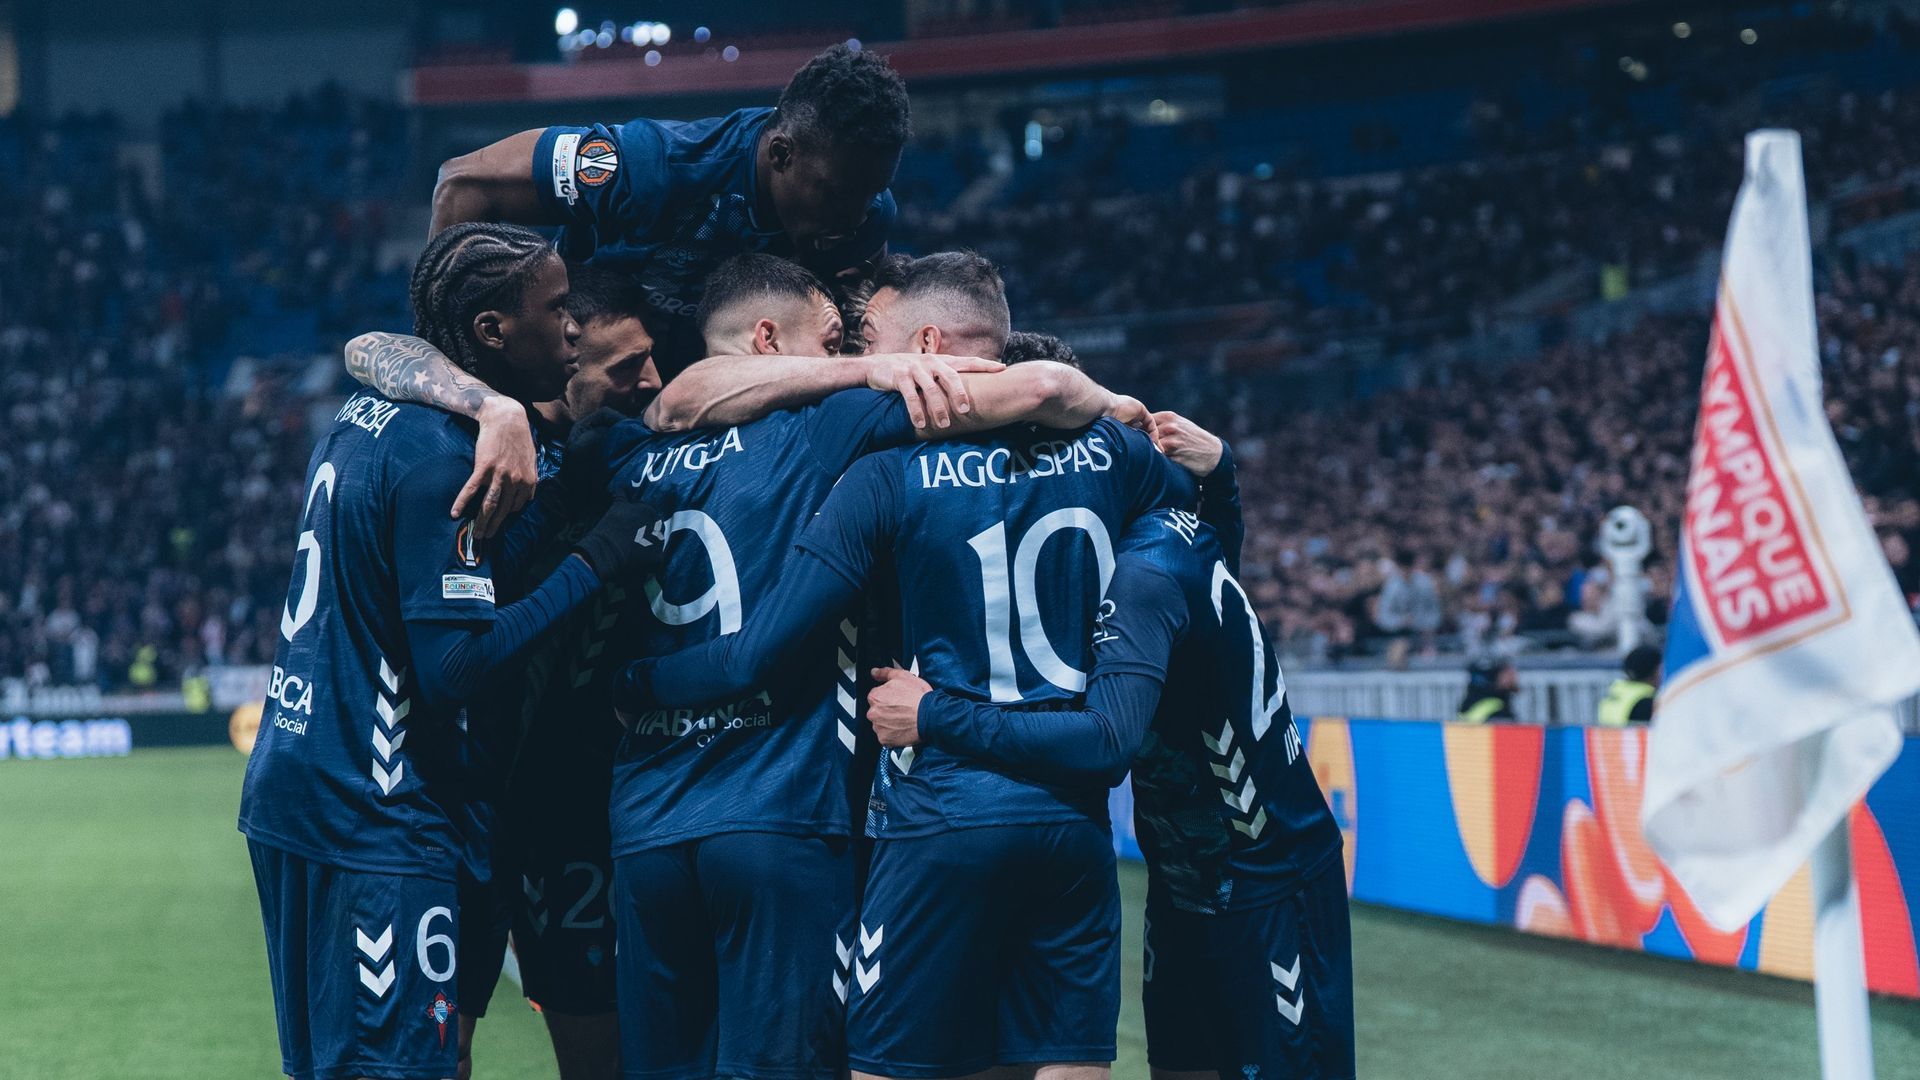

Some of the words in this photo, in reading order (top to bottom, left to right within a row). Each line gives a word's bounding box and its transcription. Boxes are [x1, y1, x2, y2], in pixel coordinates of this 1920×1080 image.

[1690, 455, 1771, 632] NAIS
[1703, 352, 1817, 613] YMPIQUE
[643, 509, 743, 636] 9
[966, 506, 1117, 703] 10
[416, 905, 457, 983] 6
[560, 861, 617, 929] 2
